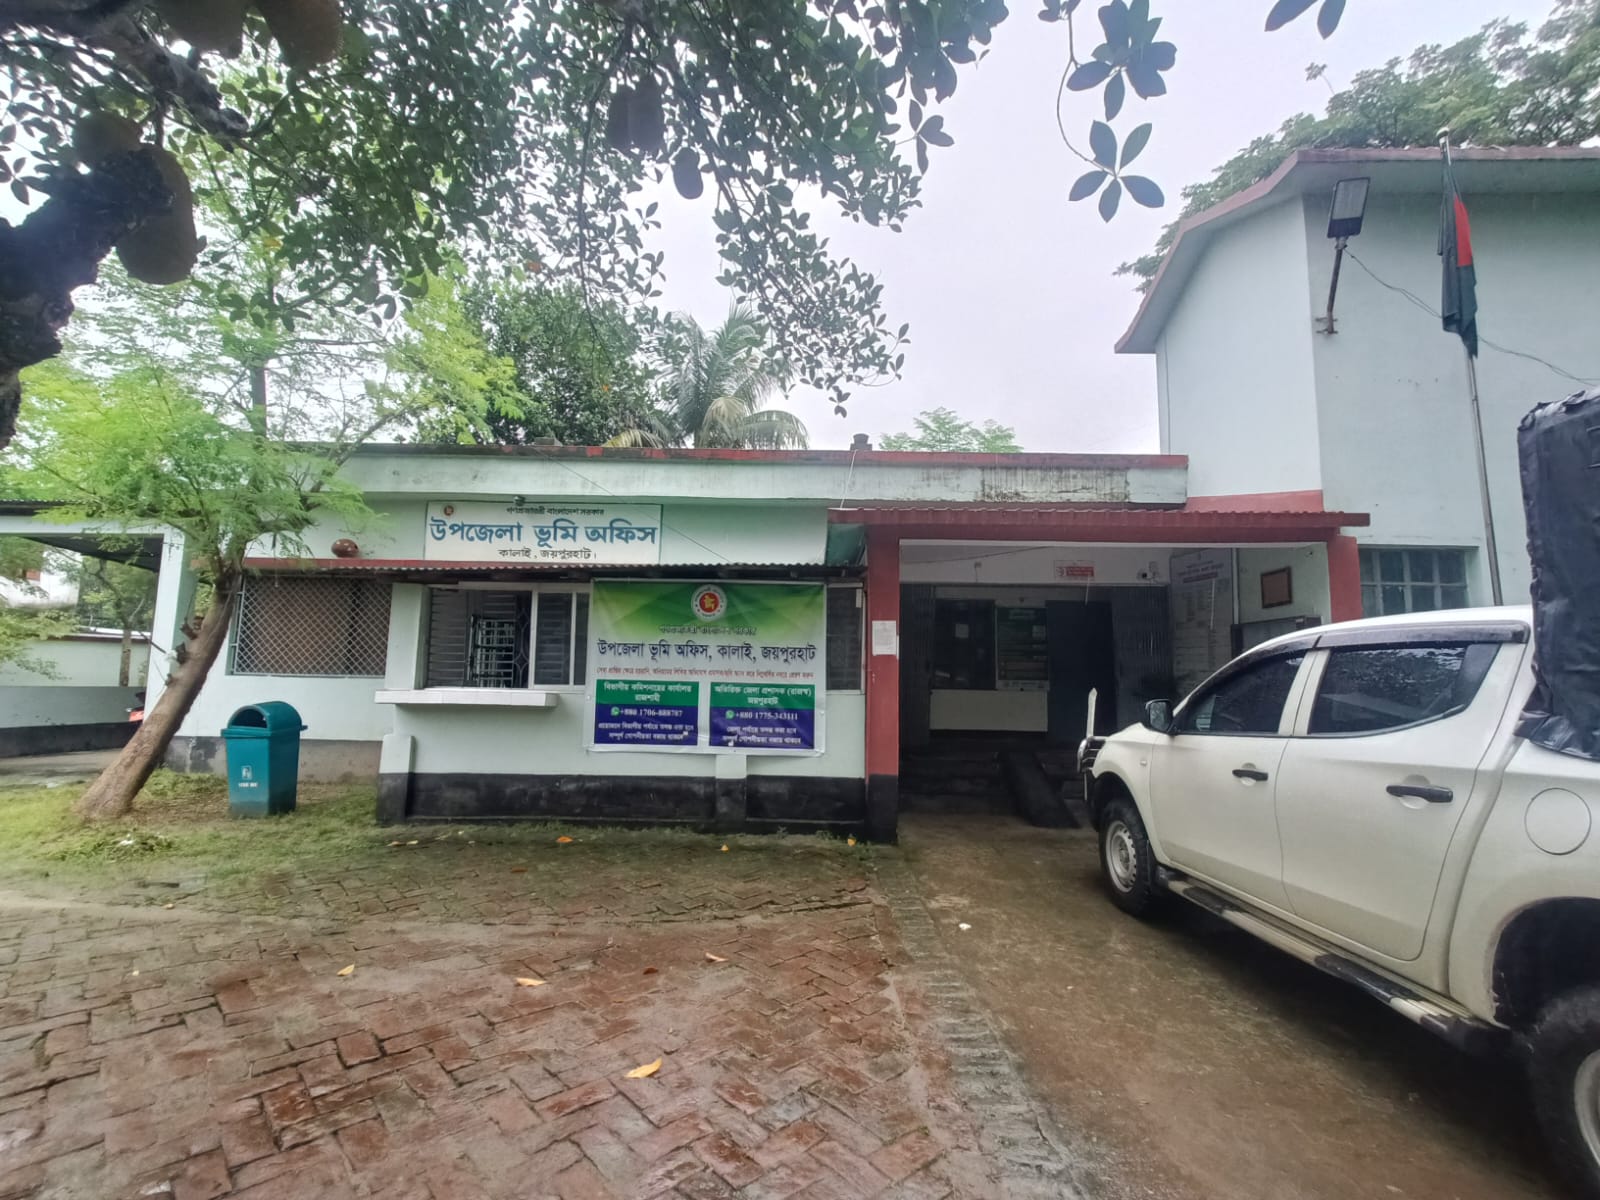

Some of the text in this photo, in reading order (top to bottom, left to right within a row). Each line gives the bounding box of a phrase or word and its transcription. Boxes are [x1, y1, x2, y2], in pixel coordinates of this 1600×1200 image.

[430, 516, 658, 548] উপজেলা ভূমি অফিস
[597, 639, 817, 664] উপজেলা ভূমি অফিস, কালাই, জয়পুরহাট
